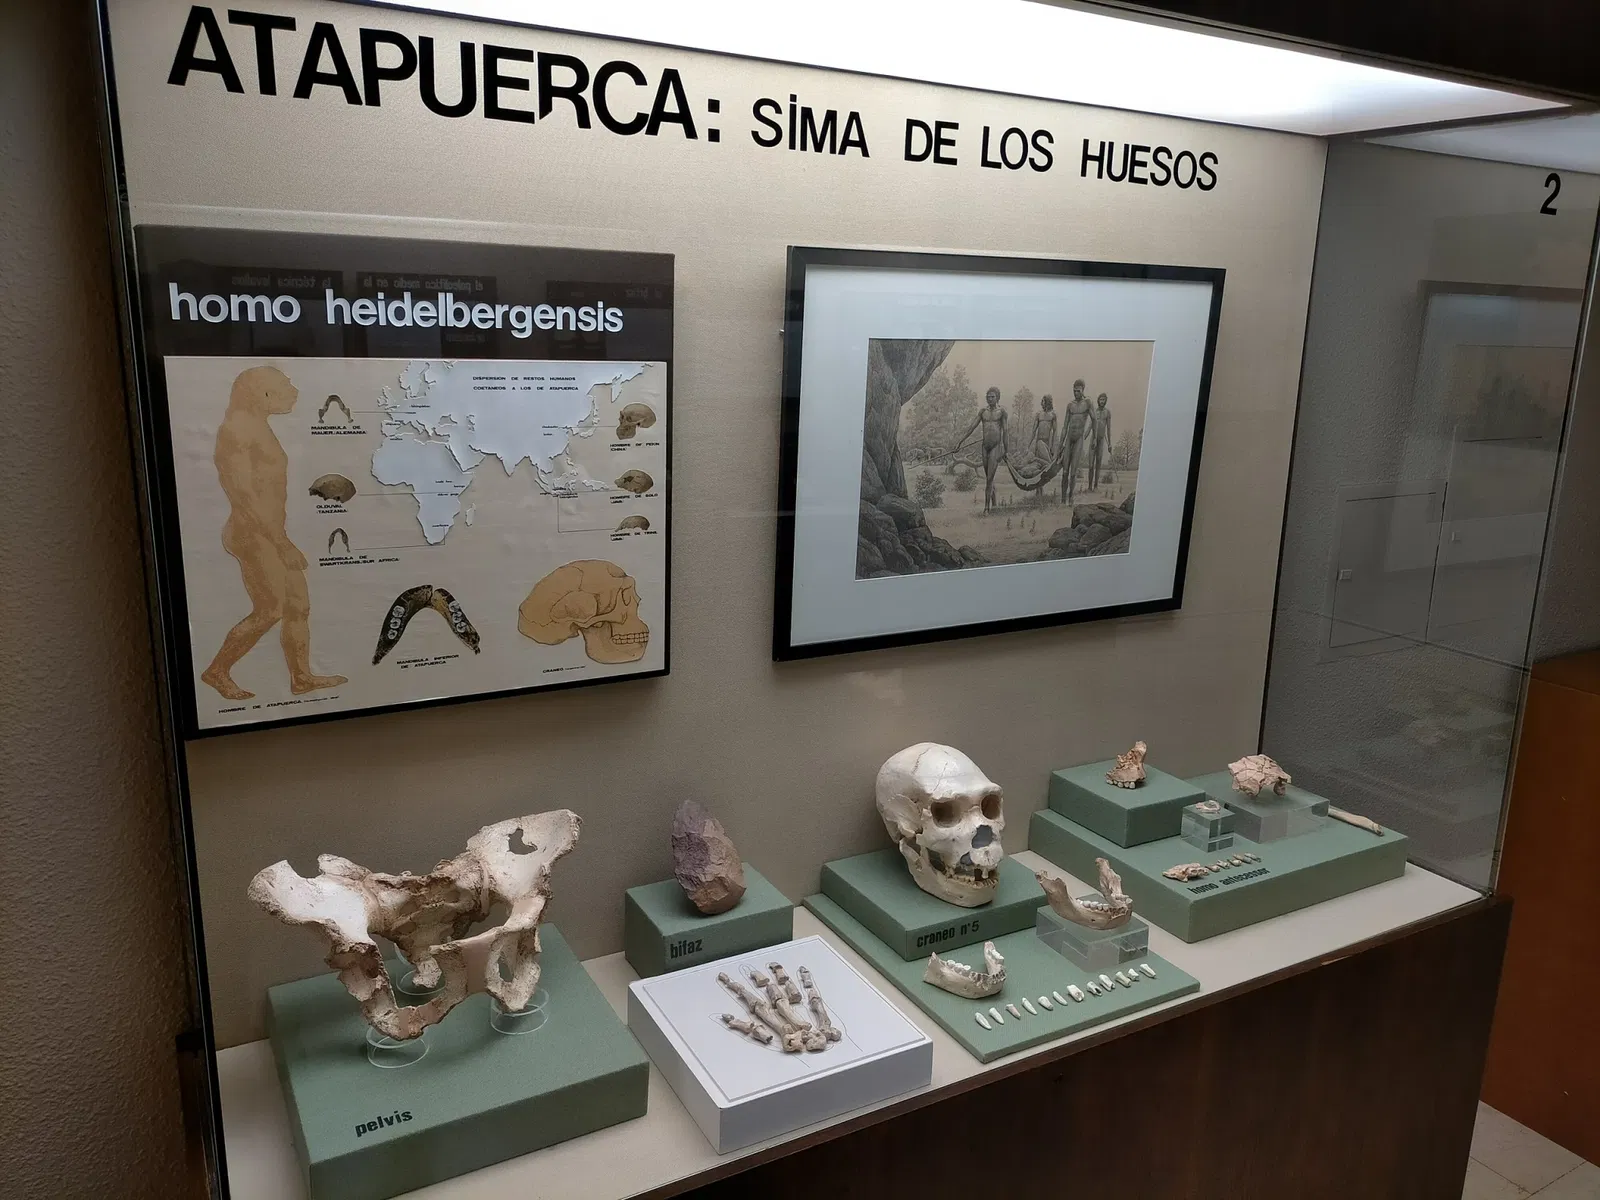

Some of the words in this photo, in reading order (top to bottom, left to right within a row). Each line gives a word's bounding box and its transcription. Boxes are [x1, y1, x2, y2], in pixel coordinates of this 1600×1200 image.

[167, 5, 721, 142] ATAPUERCA:
[904, 118, 959, 165] DE
[980, 126, 1053, 172] LOS
[1081, 138, 1218, 191] HUESOS
[1540, 172, 1561, 215] 2
[168, 282, 301, 322] homo
[326, 289, 624, 339] heidelbergensis
[414, 660, 447, 668] ATAPUERCA
[218, 706, 247, 714] HOMBRE
[266, 700, 302, 708] ATAPUERCA
[1187, 881, 1219, 895] homo
[1219, 867, 1270, 886] antecessor
[670, 939, 703, 959] bifaz
[916, 927, 955, 948] craneo
[355, 1110, 413, 1138] pelvis
